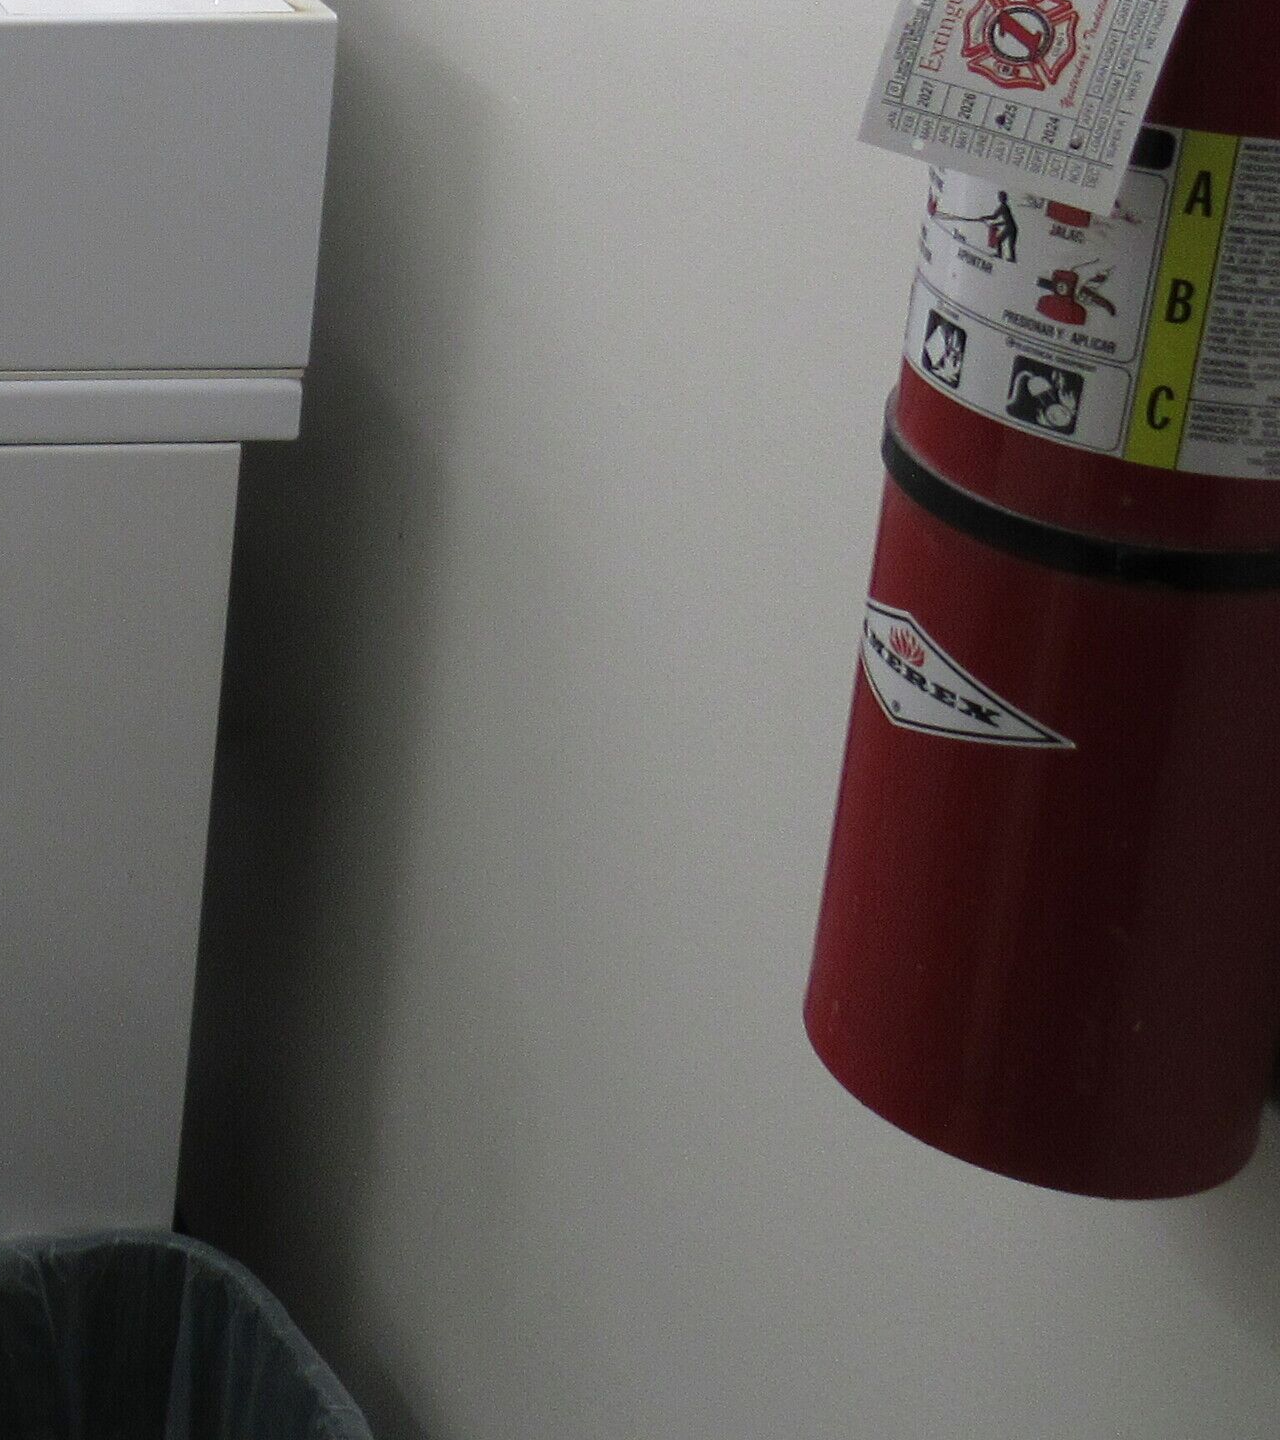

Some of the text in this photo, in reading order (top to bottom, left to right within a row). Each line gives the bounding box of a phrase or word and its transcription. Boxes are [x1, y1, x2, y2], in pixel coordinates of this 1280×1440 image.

[917, 80, 933, 107] 2027
[1060, 45, 1090, 107] Yesterday's
[958, 93, 976, 119] 2026
[1041, 116, 1059, 143] 2024
[1184, 170, 1213, 218] A
[1165, 278, 1195, 324] B
[1146, 384, 1175, 431] C
